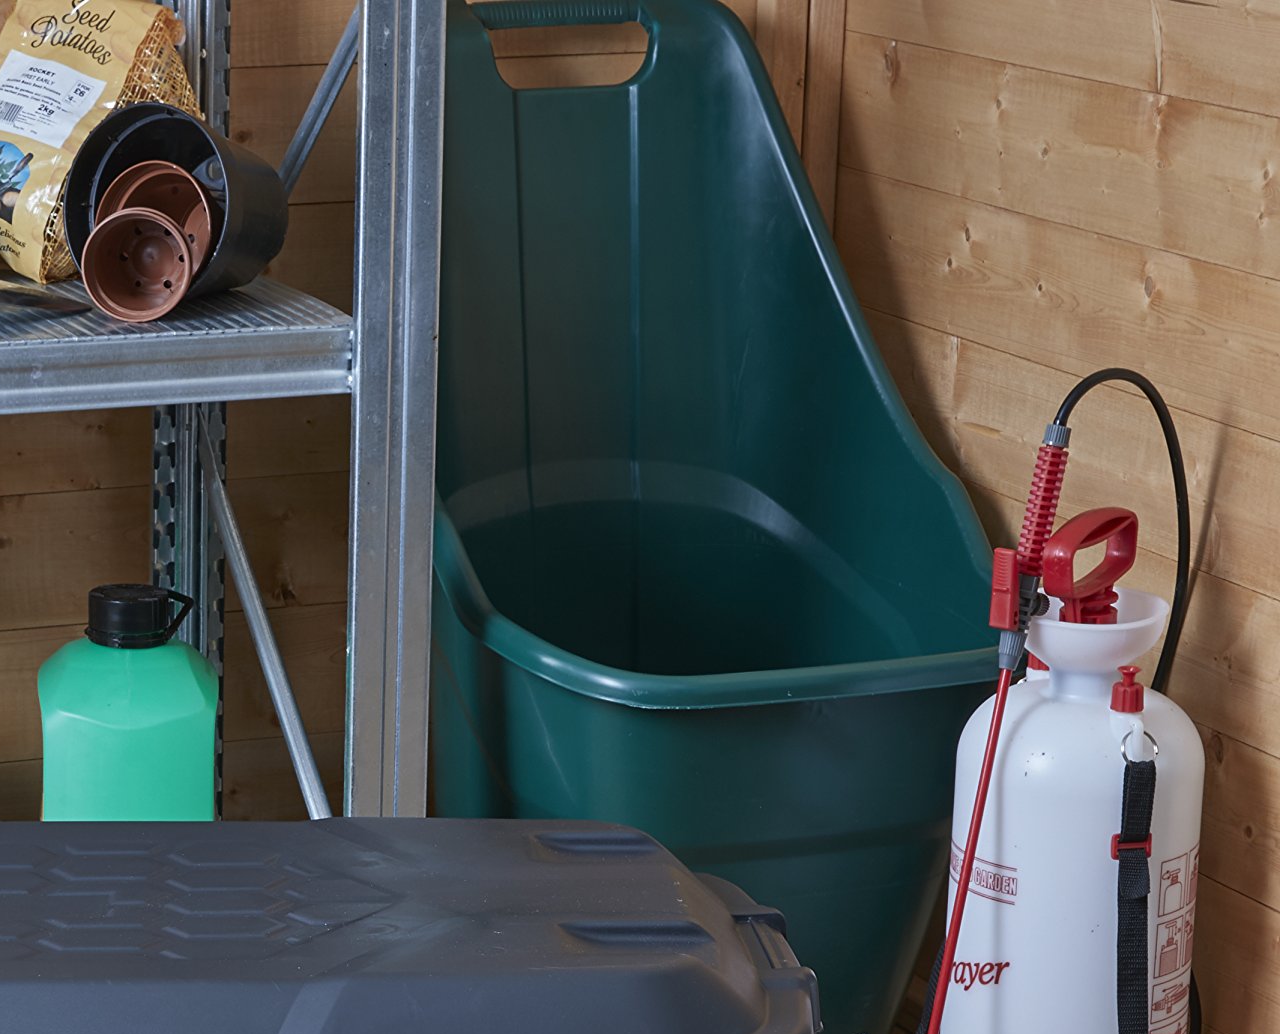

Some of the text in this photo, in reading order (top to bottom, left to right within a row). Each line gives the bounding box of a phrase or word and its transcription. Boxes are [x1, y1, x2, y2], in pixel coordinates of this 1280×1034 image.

[62, 0, 115, 33] Seed
[31, 15, 112, 65] Potatoes
[37, 103, 56, 116] 2kg
[973, 866, 1018, 897] GARDEN
